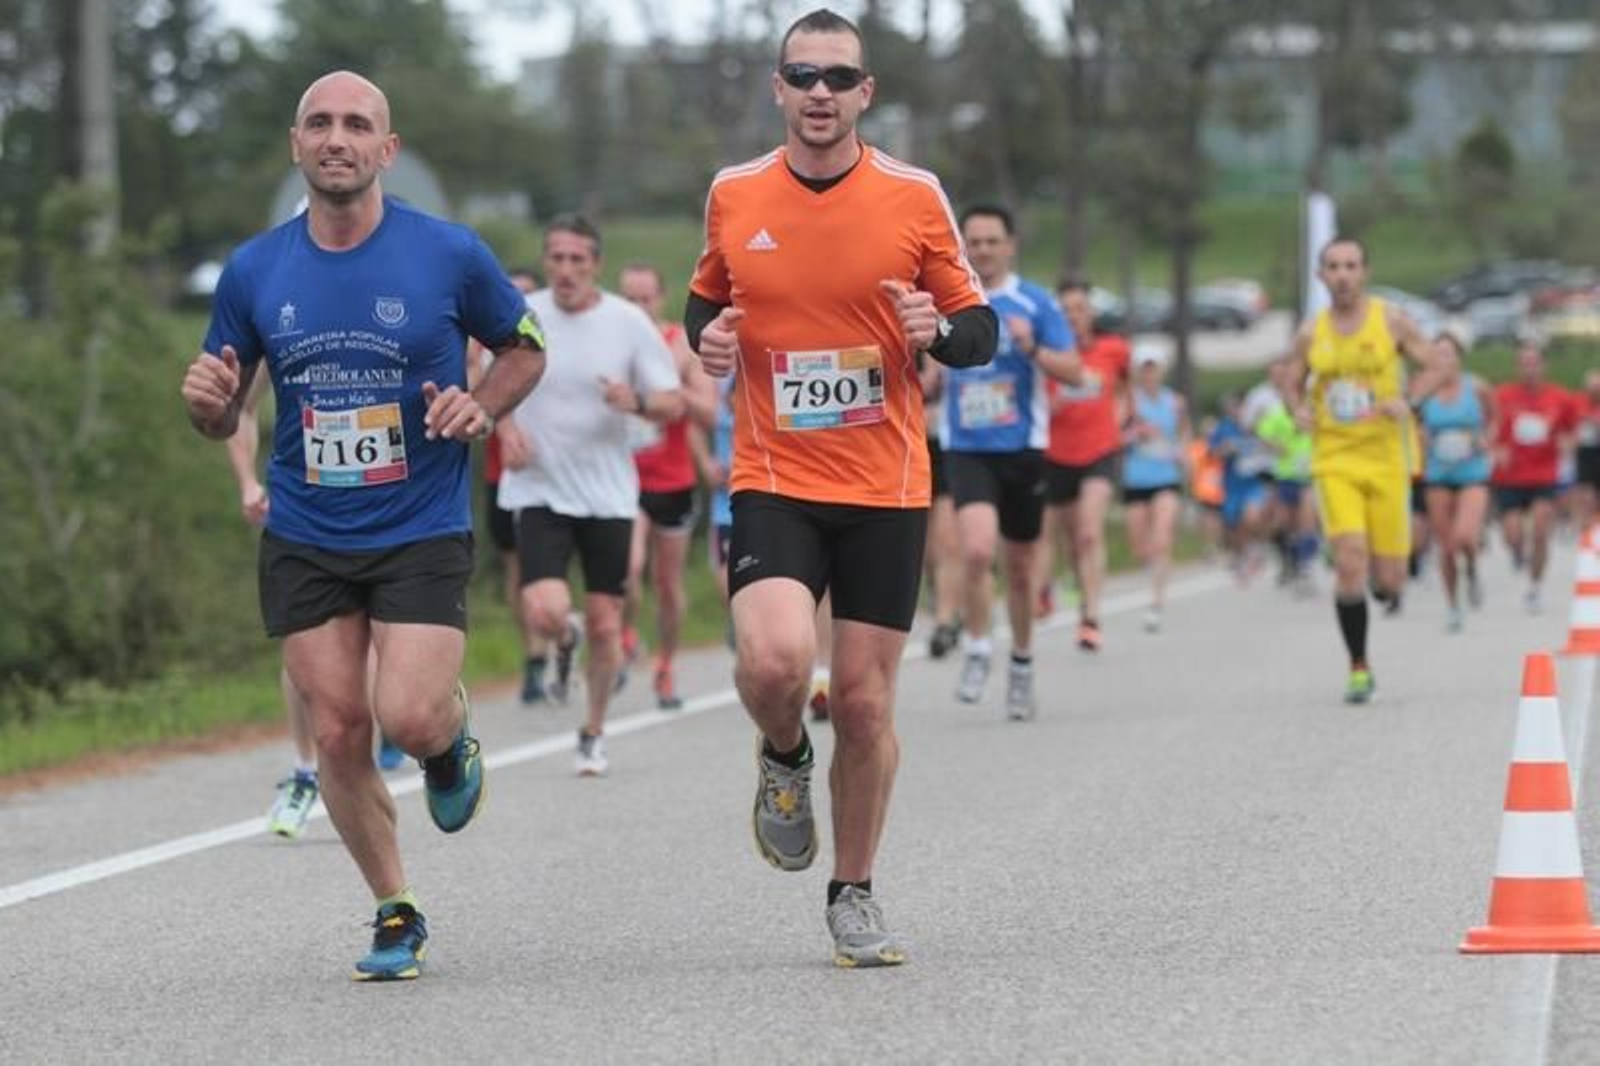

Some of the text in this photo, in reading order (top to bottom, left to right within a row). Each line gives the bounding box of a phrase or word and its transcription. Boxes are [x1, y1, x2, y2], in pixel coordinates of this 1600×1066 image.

[289, 332, 346, 352] CARREIRA
[349, 331, 400, 350] POPULAR
[325, 341, 341, 351] DE
[345, 341, 408, 365] REDONDELA
[310, 369, 402, 384] MEDIOLANUM
[783, 377, 858, 408] 790
[311, 436, 378, 466] 716
